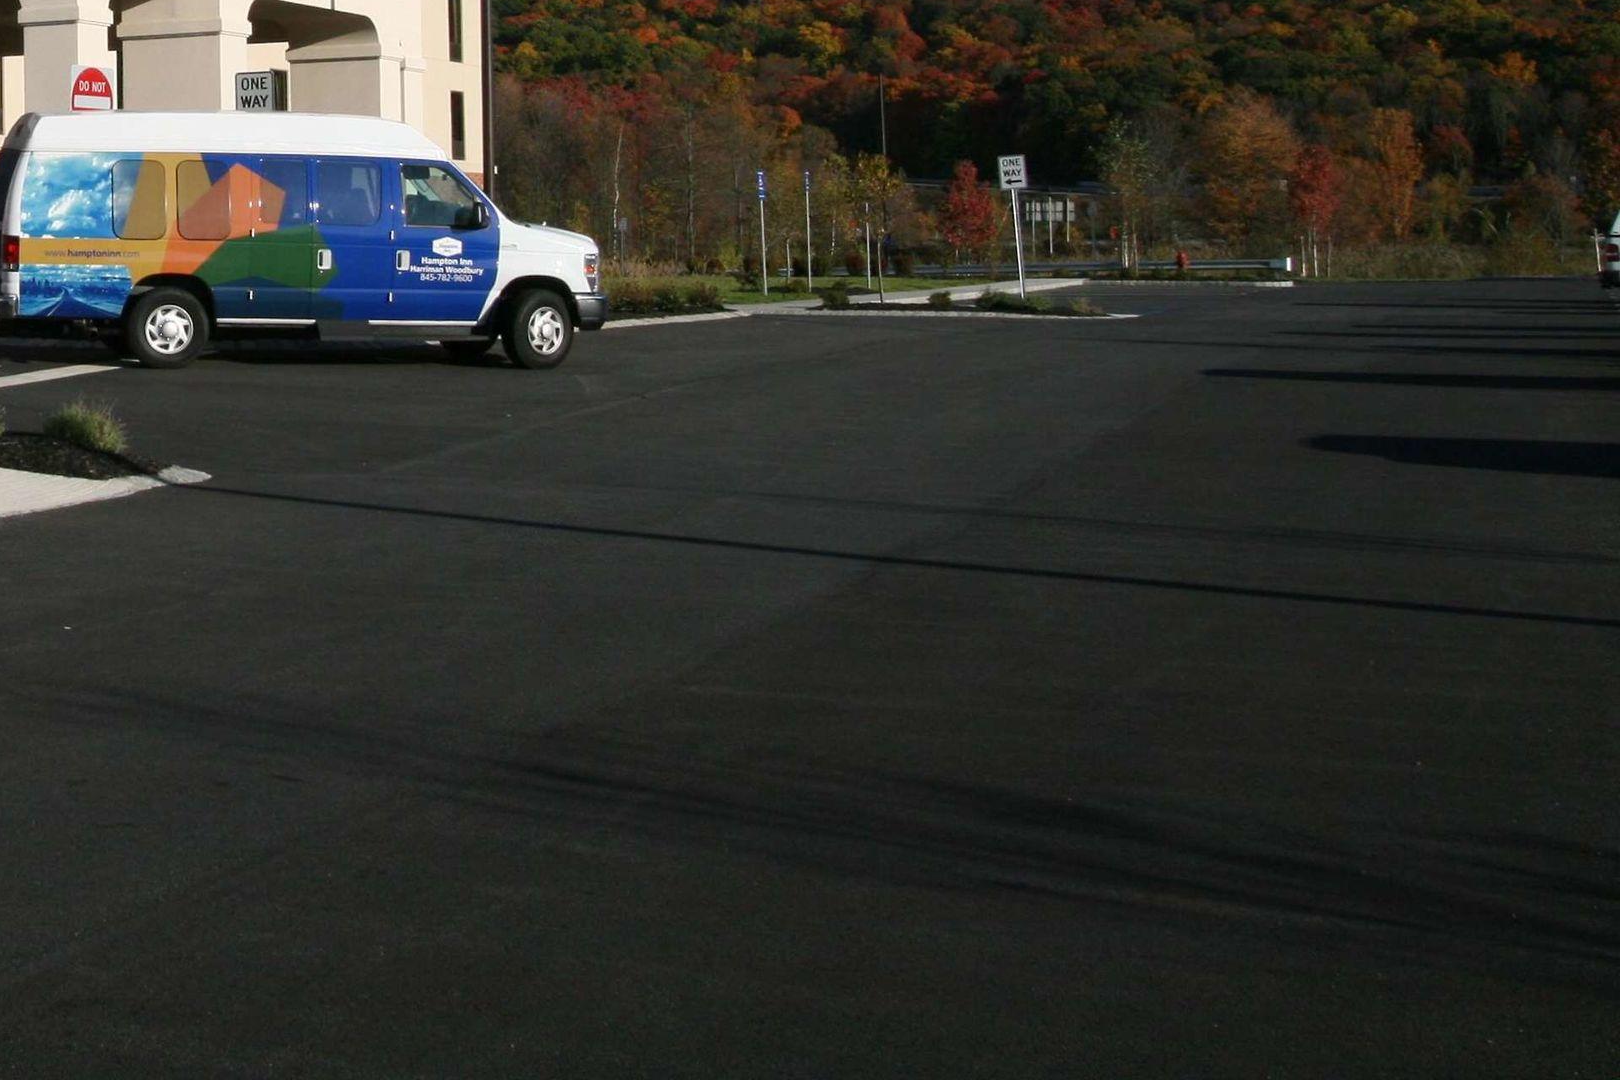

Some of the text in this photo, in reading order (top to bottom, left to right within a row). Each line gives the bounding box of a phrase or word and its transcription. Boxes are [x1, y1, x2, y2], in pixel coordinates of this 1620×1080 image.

[78, 80, 107, 94] DO NOT
[241, 77, 268, 91] ONE
[240, 95, 269, 108] WAY
[1002, 157, 1021, 167] ONE
[1002, 169, 1022, 177] WAY
[44, 249, 140, 259] www.hamptoninn.com
[421, 256, 474, 267] Hampton Inn
[410, 265, 485, 277] Harriman Woodbury
